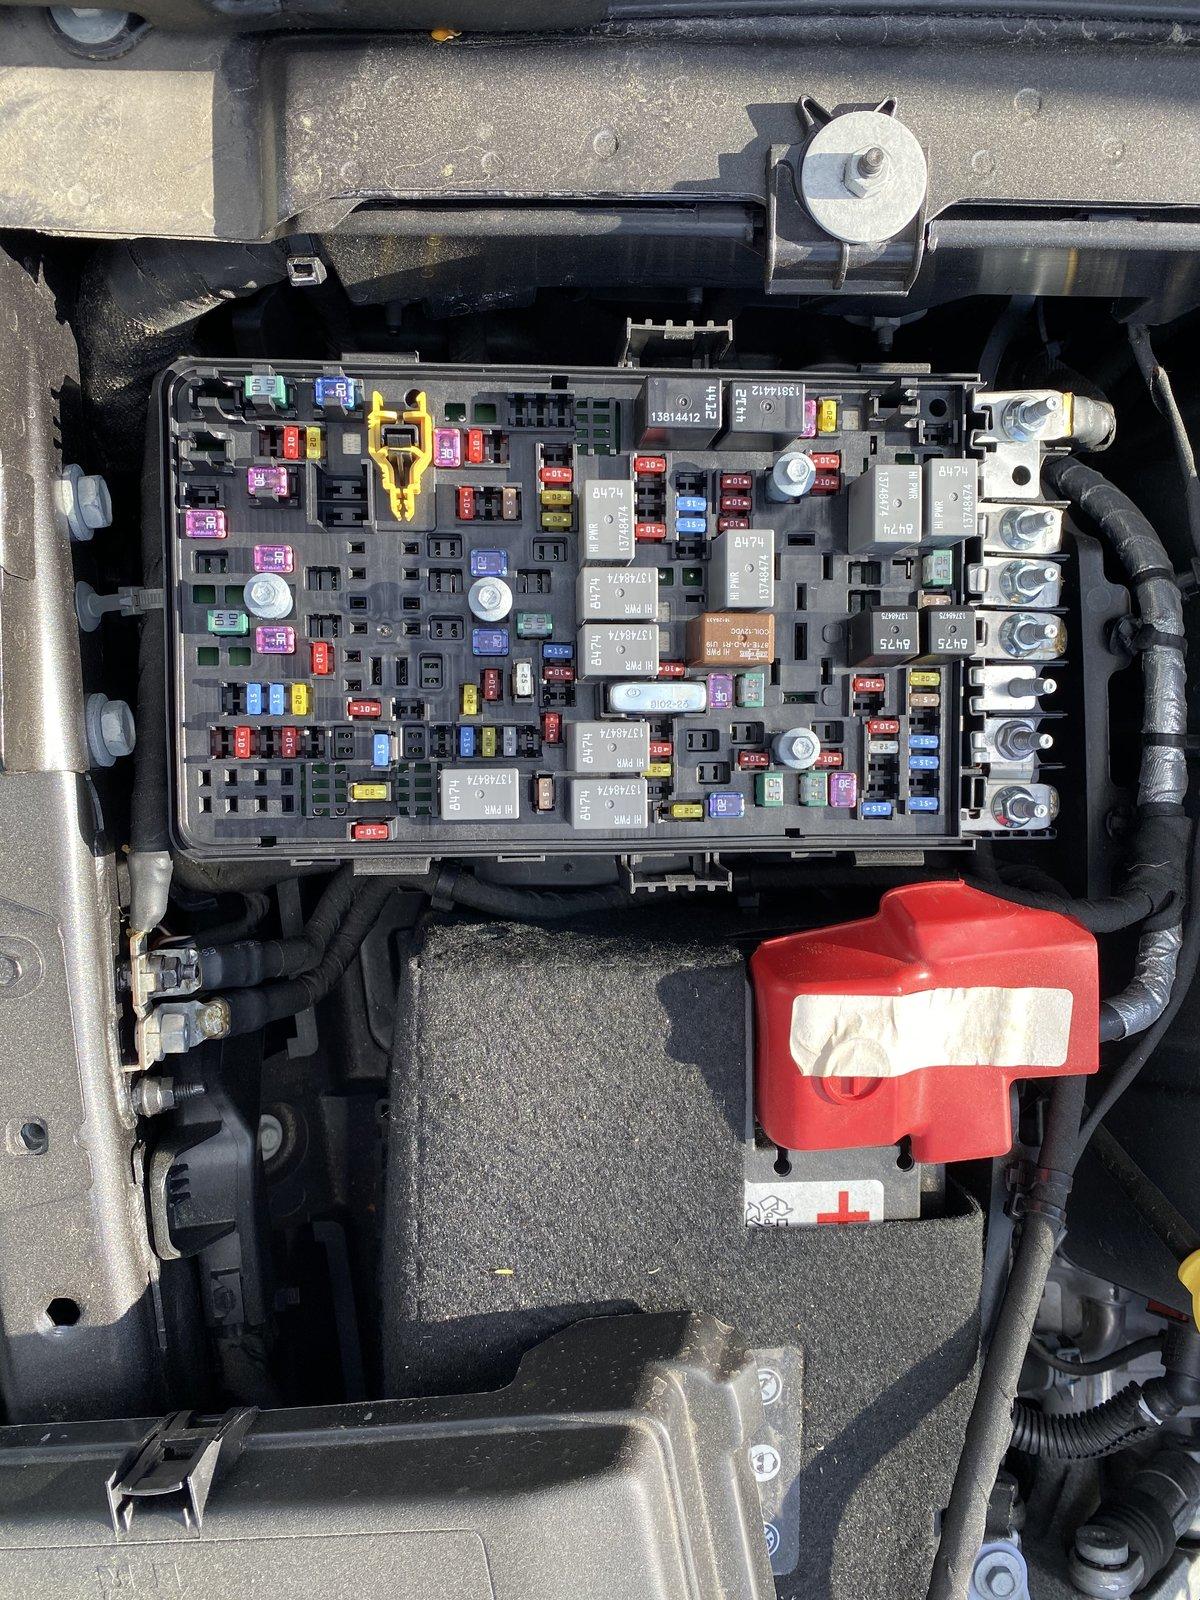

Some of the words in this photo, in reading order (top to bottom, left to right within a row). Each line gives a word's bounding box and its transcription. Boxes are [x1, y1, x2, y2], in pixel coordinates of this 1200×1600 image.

[336, 383, 347, 397] 20
[752, 386, 800, 396] 13814412
[706, 386, 717, 420] 4412
[736, 389, 746, 422] 4412
[651, 412, 700, 423] 13814412
[440, 449, 453, 459] 30
[551, 470, 562, 478] 10
[908, 471, 918, 480] HI
[939, 465, 968, 477] 8474
[255, 473, 265, 487] 30
[592, 487, 624, 499] 8474
[878, 471, 889, 517] 13748474
[908, 482, 918, 500] PWR
[464, 499, 471, 508] 10
[933, 500, 944, 517] PWR
[963, 484, 973, 528] 13748474
[206, 516, 216, 529] 30
[619, 505, 629, 551] 13748474
[933, 519, 943, 529] HI
[589, 523, 599, 541] PWR
[883, 524, 913, 534] 8474
[734, 536, 764, 548] 8474
[589, 543, 599, 553] HI
[275, 551, 285, 565] 30
[477, 556, 487, 570] 20
[607, 573, 652, 584] 13748474
[729, 571, 739, 589] PWR
[759, 554, 769, 599] 13748474
[590, 577, 600, 609] 8474
[729, 590, 739, 600] HI
[624, 604, 641, 614] PWR
[644, 604, 652, 614] HI
[214, 613, 224, 626] 40
[276, 632, 286, 646] 30
[608, 630, 653, 641] 13748474
[880, 639, 911, 650] 8475
[938, 638, 968, 649] 8475
[591, 634, 602, 666] 8474
[316, 653, 323, 663] 10
[625, 661, 643, 671] PWR
[645, 661, 653, 671] HI
[521, 673, 528, 683] 25
[488, 679, 495, 689] 10
[250, 693, 258, 703] 15
[273, 693, 280, 704] 15
[296, 694, 302, 704] 20
[467, 694, 473, 704] 20
[549, 724, 555, 734] 10
[600, 728, 643, 739] 13748474
[238, 737, 245, 747] 10
[285, 738, 293, 748] 10
[464, 737, 471, 748] 15
[377, 744, 385, 755] 15
[583, 733, 593, 764] 8474
[617, 758, 633, 768] PWR
[636, 758, 644, 768] HI
[467, 775, 512, 786] 13748474
[838, 779, 850, 789] 30
[449, 780, 461, 811] 8474
[597, 785, 641, 796] 13748474
[484, 805, 501, 814] PWR
[504, 805, 512, 814] HI
[580, 790, 591, 821] 8474
[718, 799, 727, 811] 20
[614, 815, 631, 825] PWR
[633, 815, 642, 825] HI
